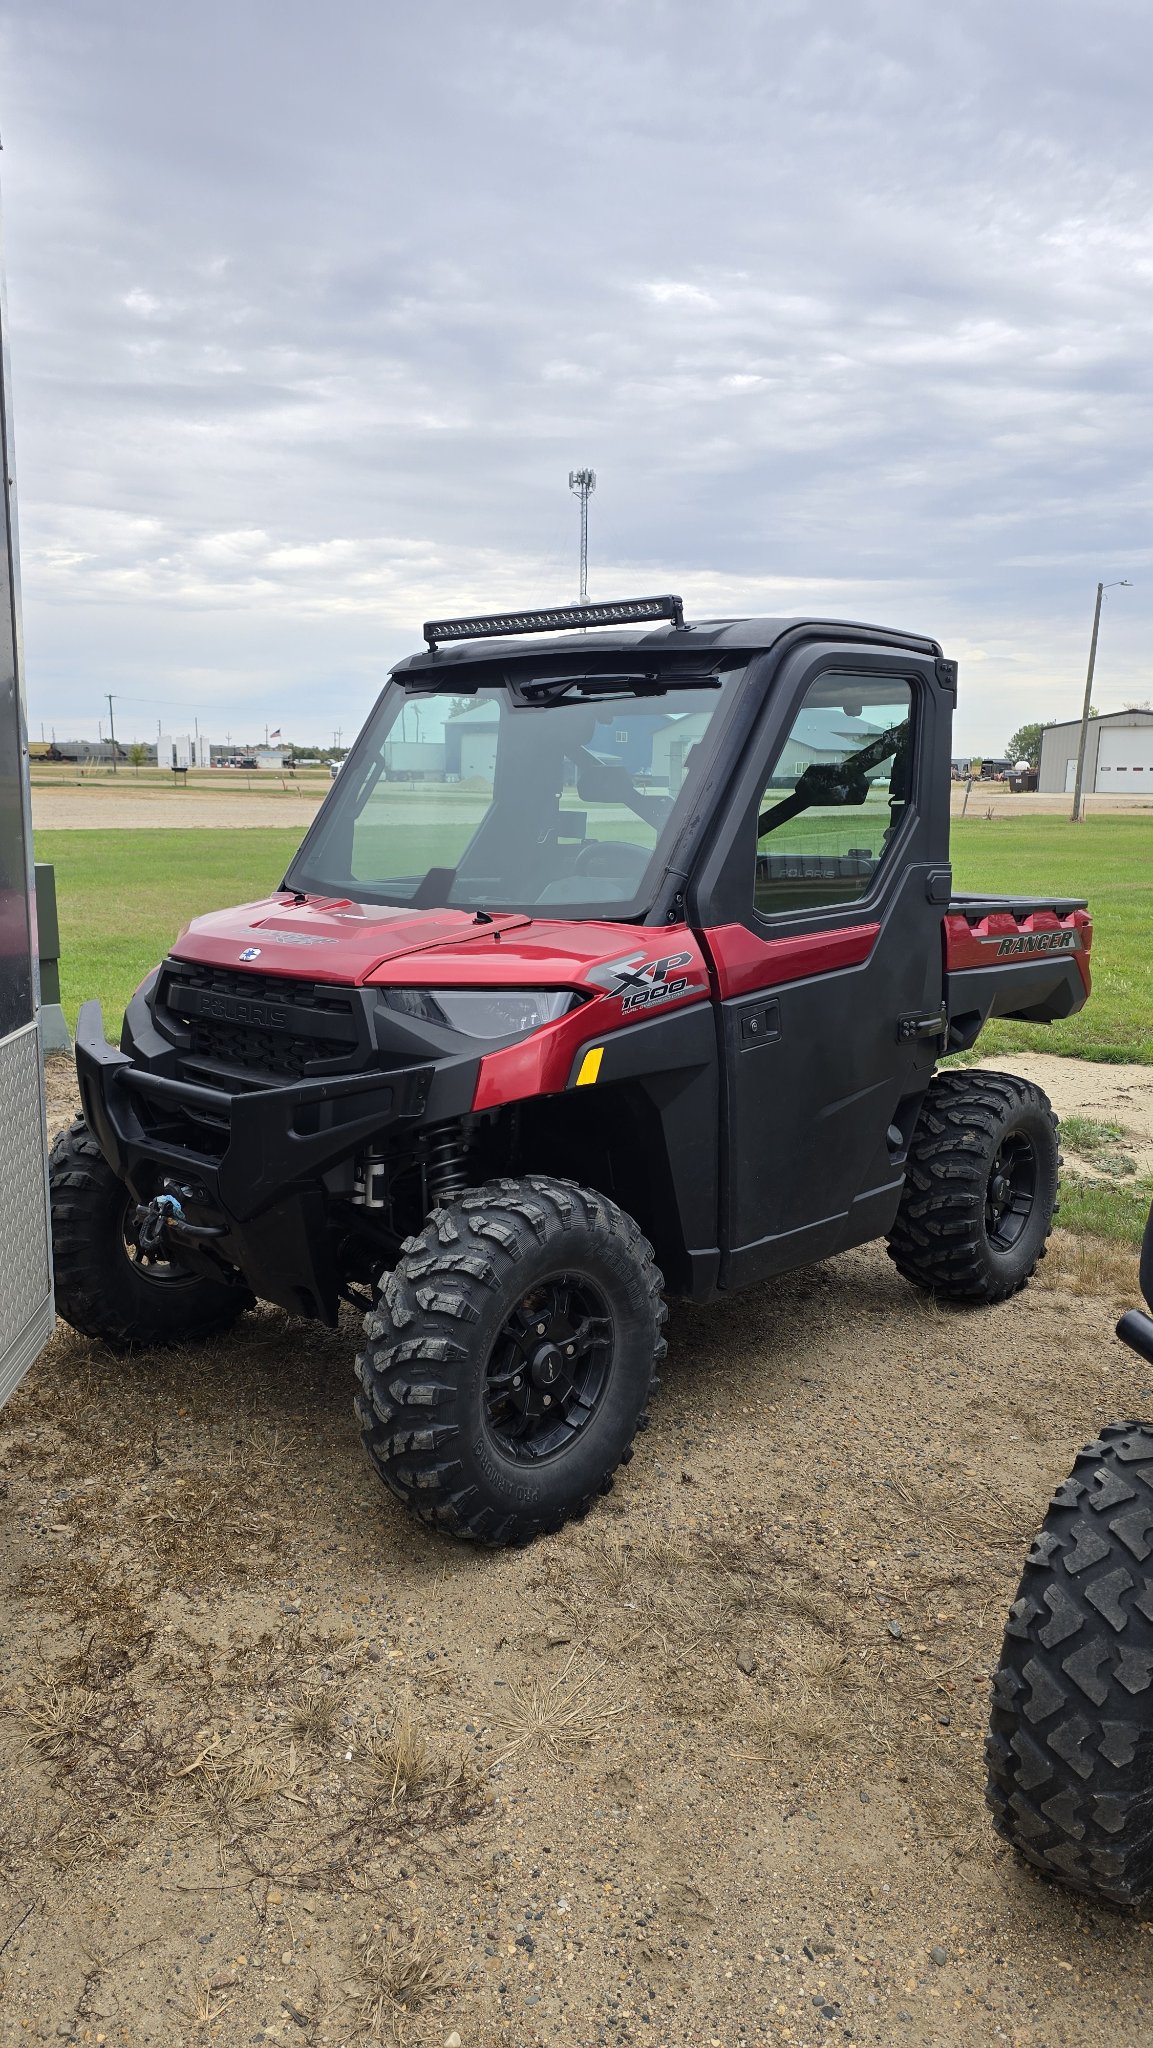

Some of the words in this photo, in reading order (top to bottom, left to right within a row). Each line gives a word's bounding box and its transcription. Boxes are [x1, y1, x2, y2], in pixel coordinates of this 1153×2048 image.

[780, 868, 835, 879] POLARIS
[997, 932, 1073, 955] RANGER
[599, 950, 694, 1003] XP
[622, 978, 687, 1010] 1000
[200, 998, 287, 1029] POLARIS
[480, 1456, 514, 1498] ARMOR
[516, 1482, 541, 1505] PRO
